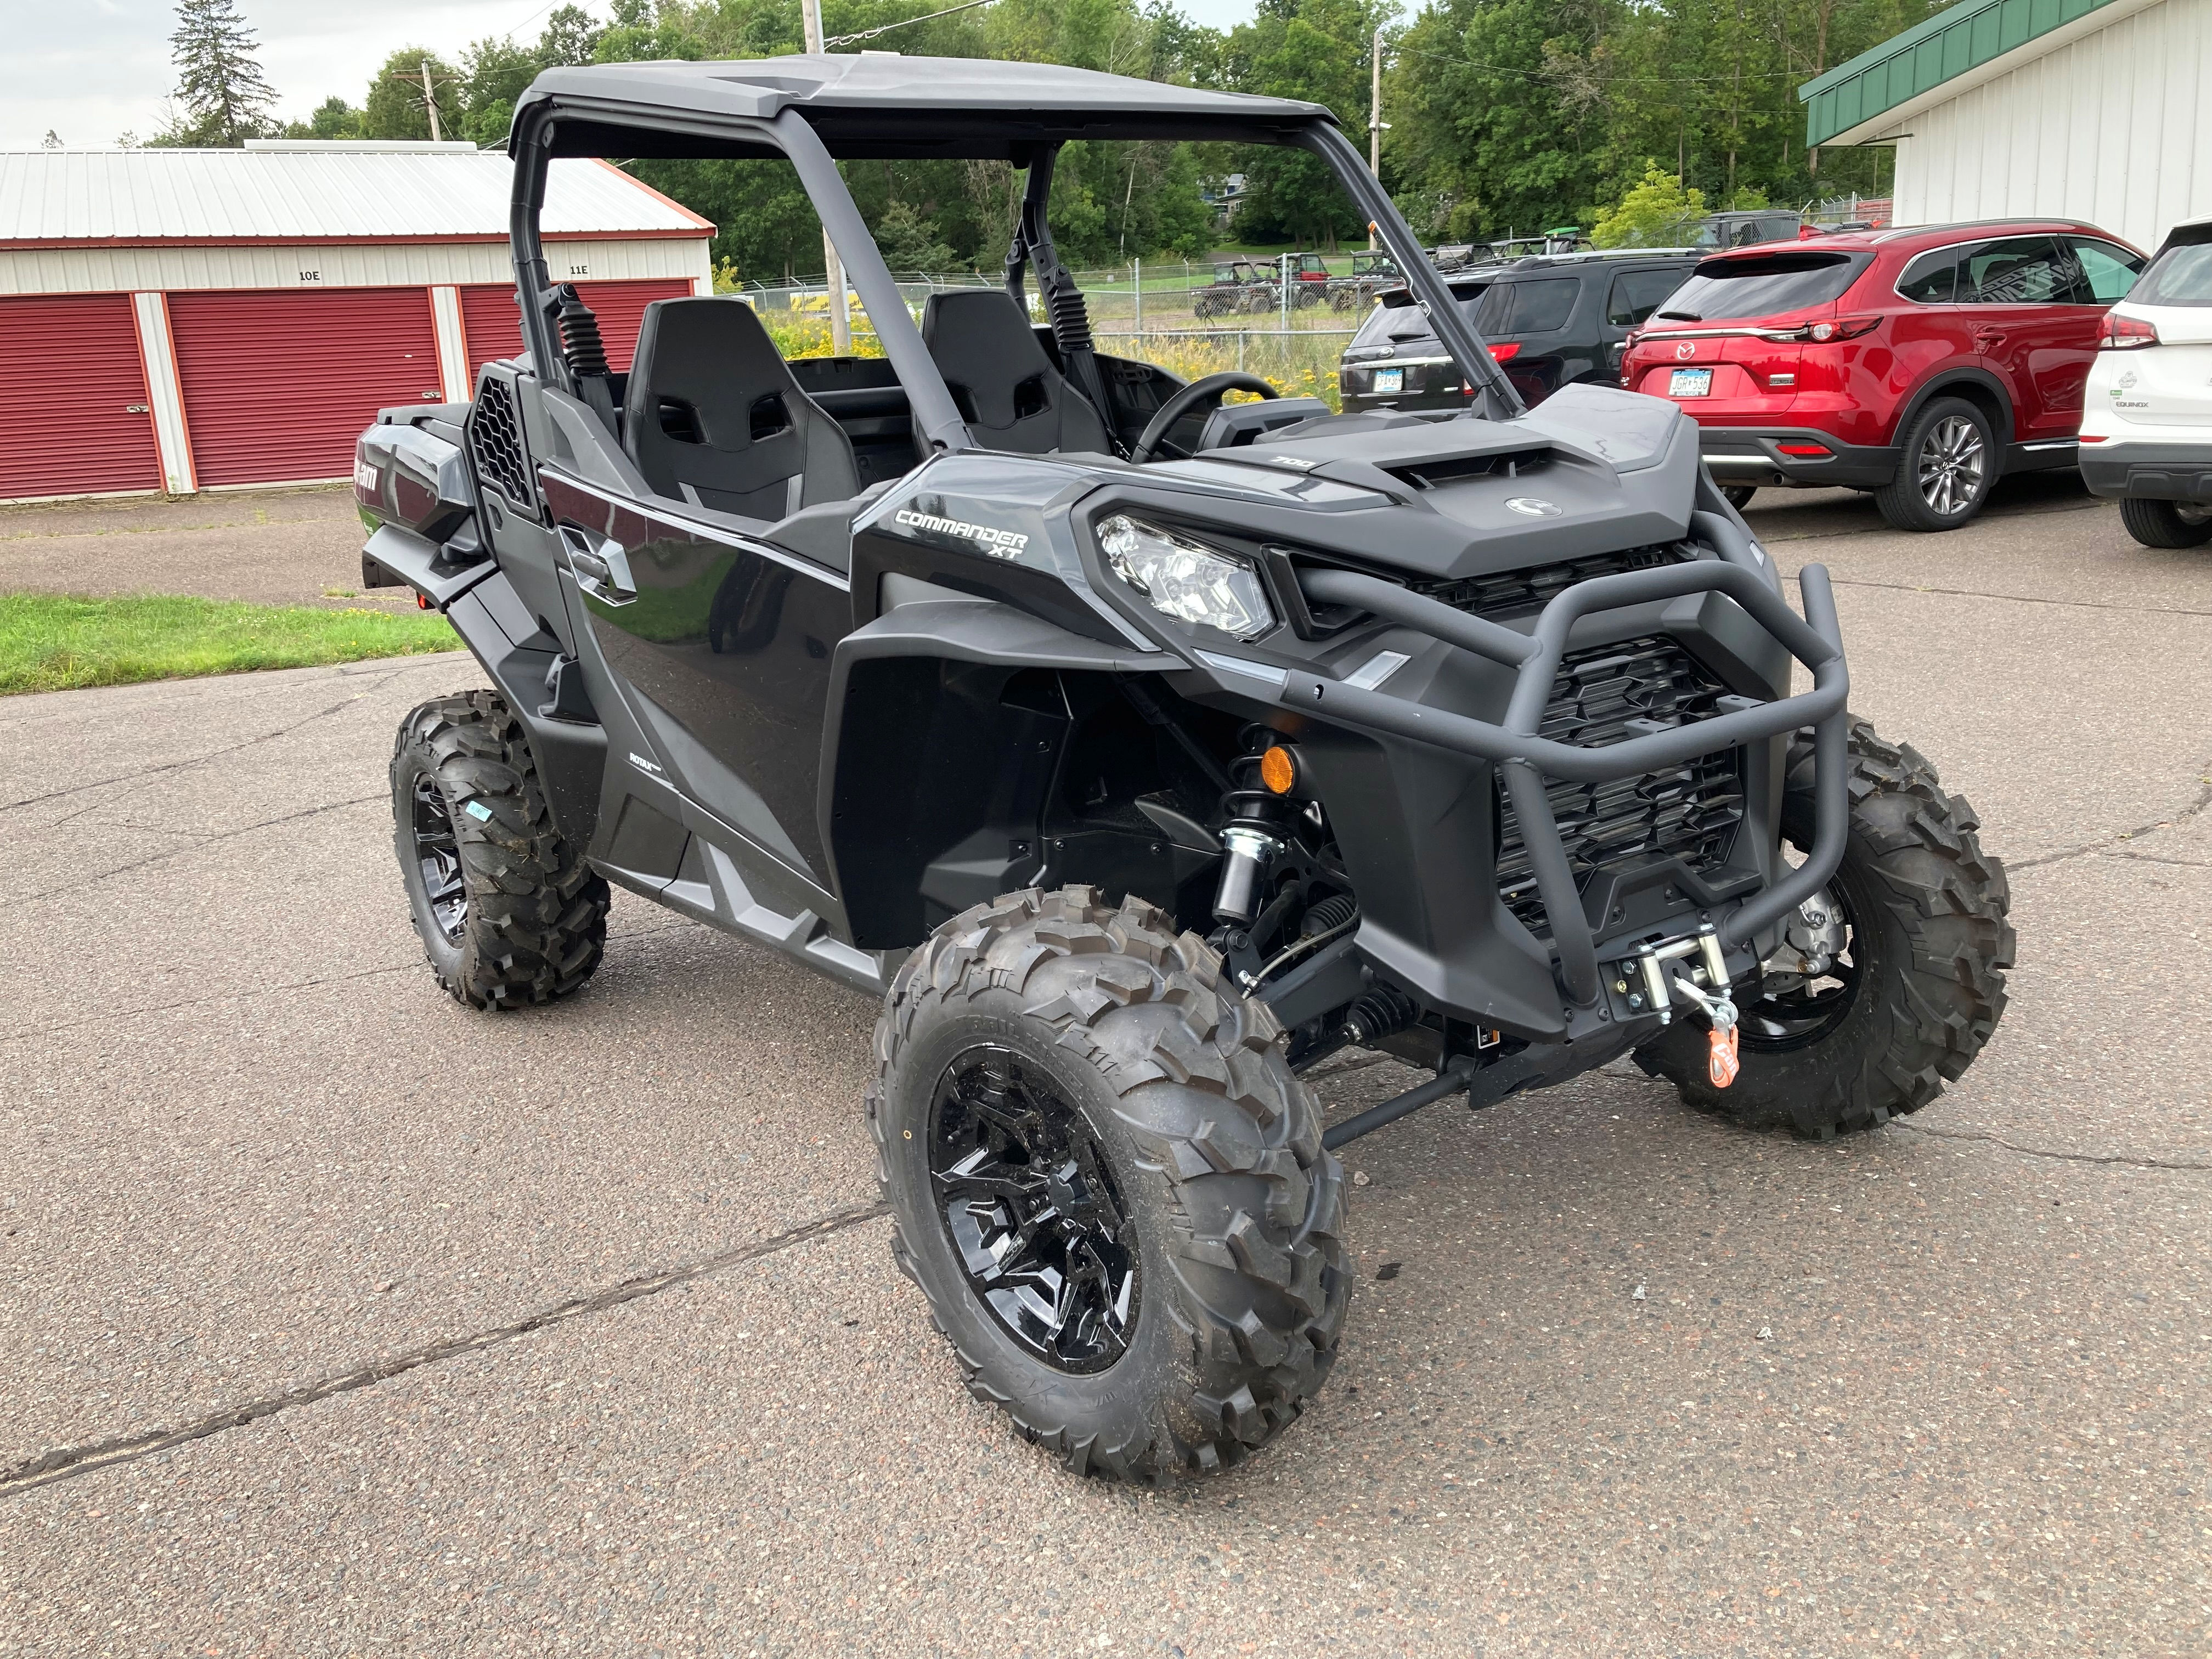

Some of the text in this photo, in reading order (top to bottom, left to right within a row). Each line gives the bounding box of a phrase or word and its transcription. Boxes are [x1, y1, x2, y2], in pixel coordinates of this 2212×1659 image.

[300, 271, 320, 280] 10E
[571, 266, 588, 274] 11E
[1673, 376, 1708, 390] JGR 536
[1270, 456, 1316, 467] 700
[895, 509, 1029, 549] COMMANDER
[988, 544, 1024, 559] XT
[629, 752, 652, 771] ROTAX
